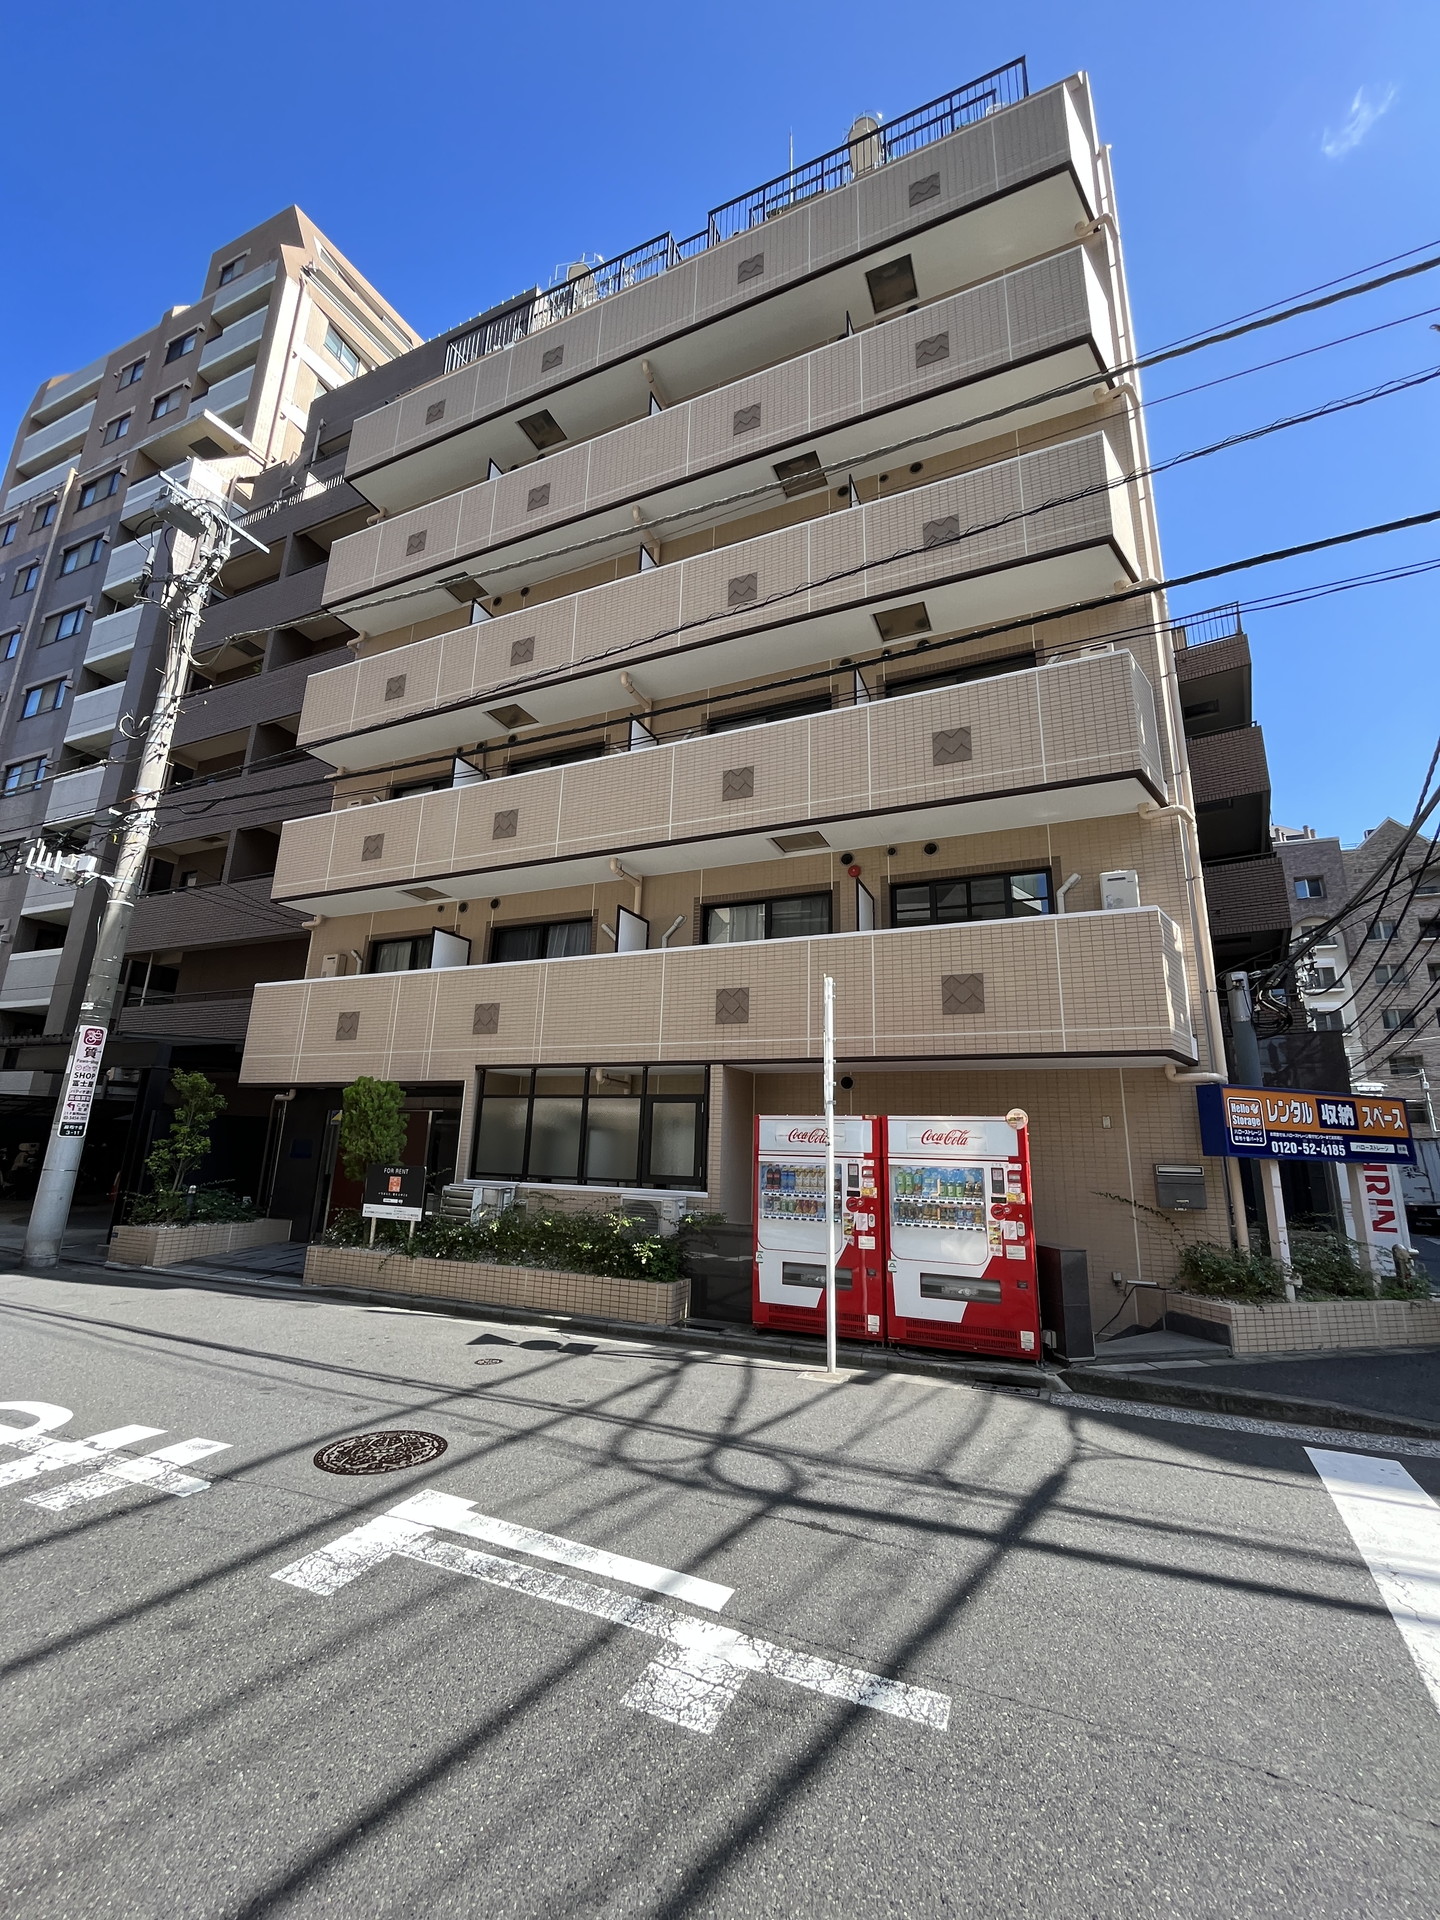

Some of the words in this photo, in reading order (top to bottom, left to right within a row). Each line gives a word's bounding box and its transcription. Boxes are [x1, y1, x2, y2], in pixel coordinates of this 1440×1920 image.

[84, 1046, 97, 1059] 質
[73, 1071, 96, 1079] SHOP
[1230, 1103, 1250, 1114] Hello
[1266, 1099, 1313, 1124] レンタル
[1321, 1103, 1355, 1126] 収納
[1361, 1106, 1404, 1129] スペース
[1232, 1114, 1261, 1127] Storage
[920, 1128, 970, 1145] Coca-Cola
[1271, 1141, 1346, 1156] 0120-52-4185
[1356, 1144, 1390, 1152] ハローストレージ
[1362, 1163, 1398, 1233] IRIN
